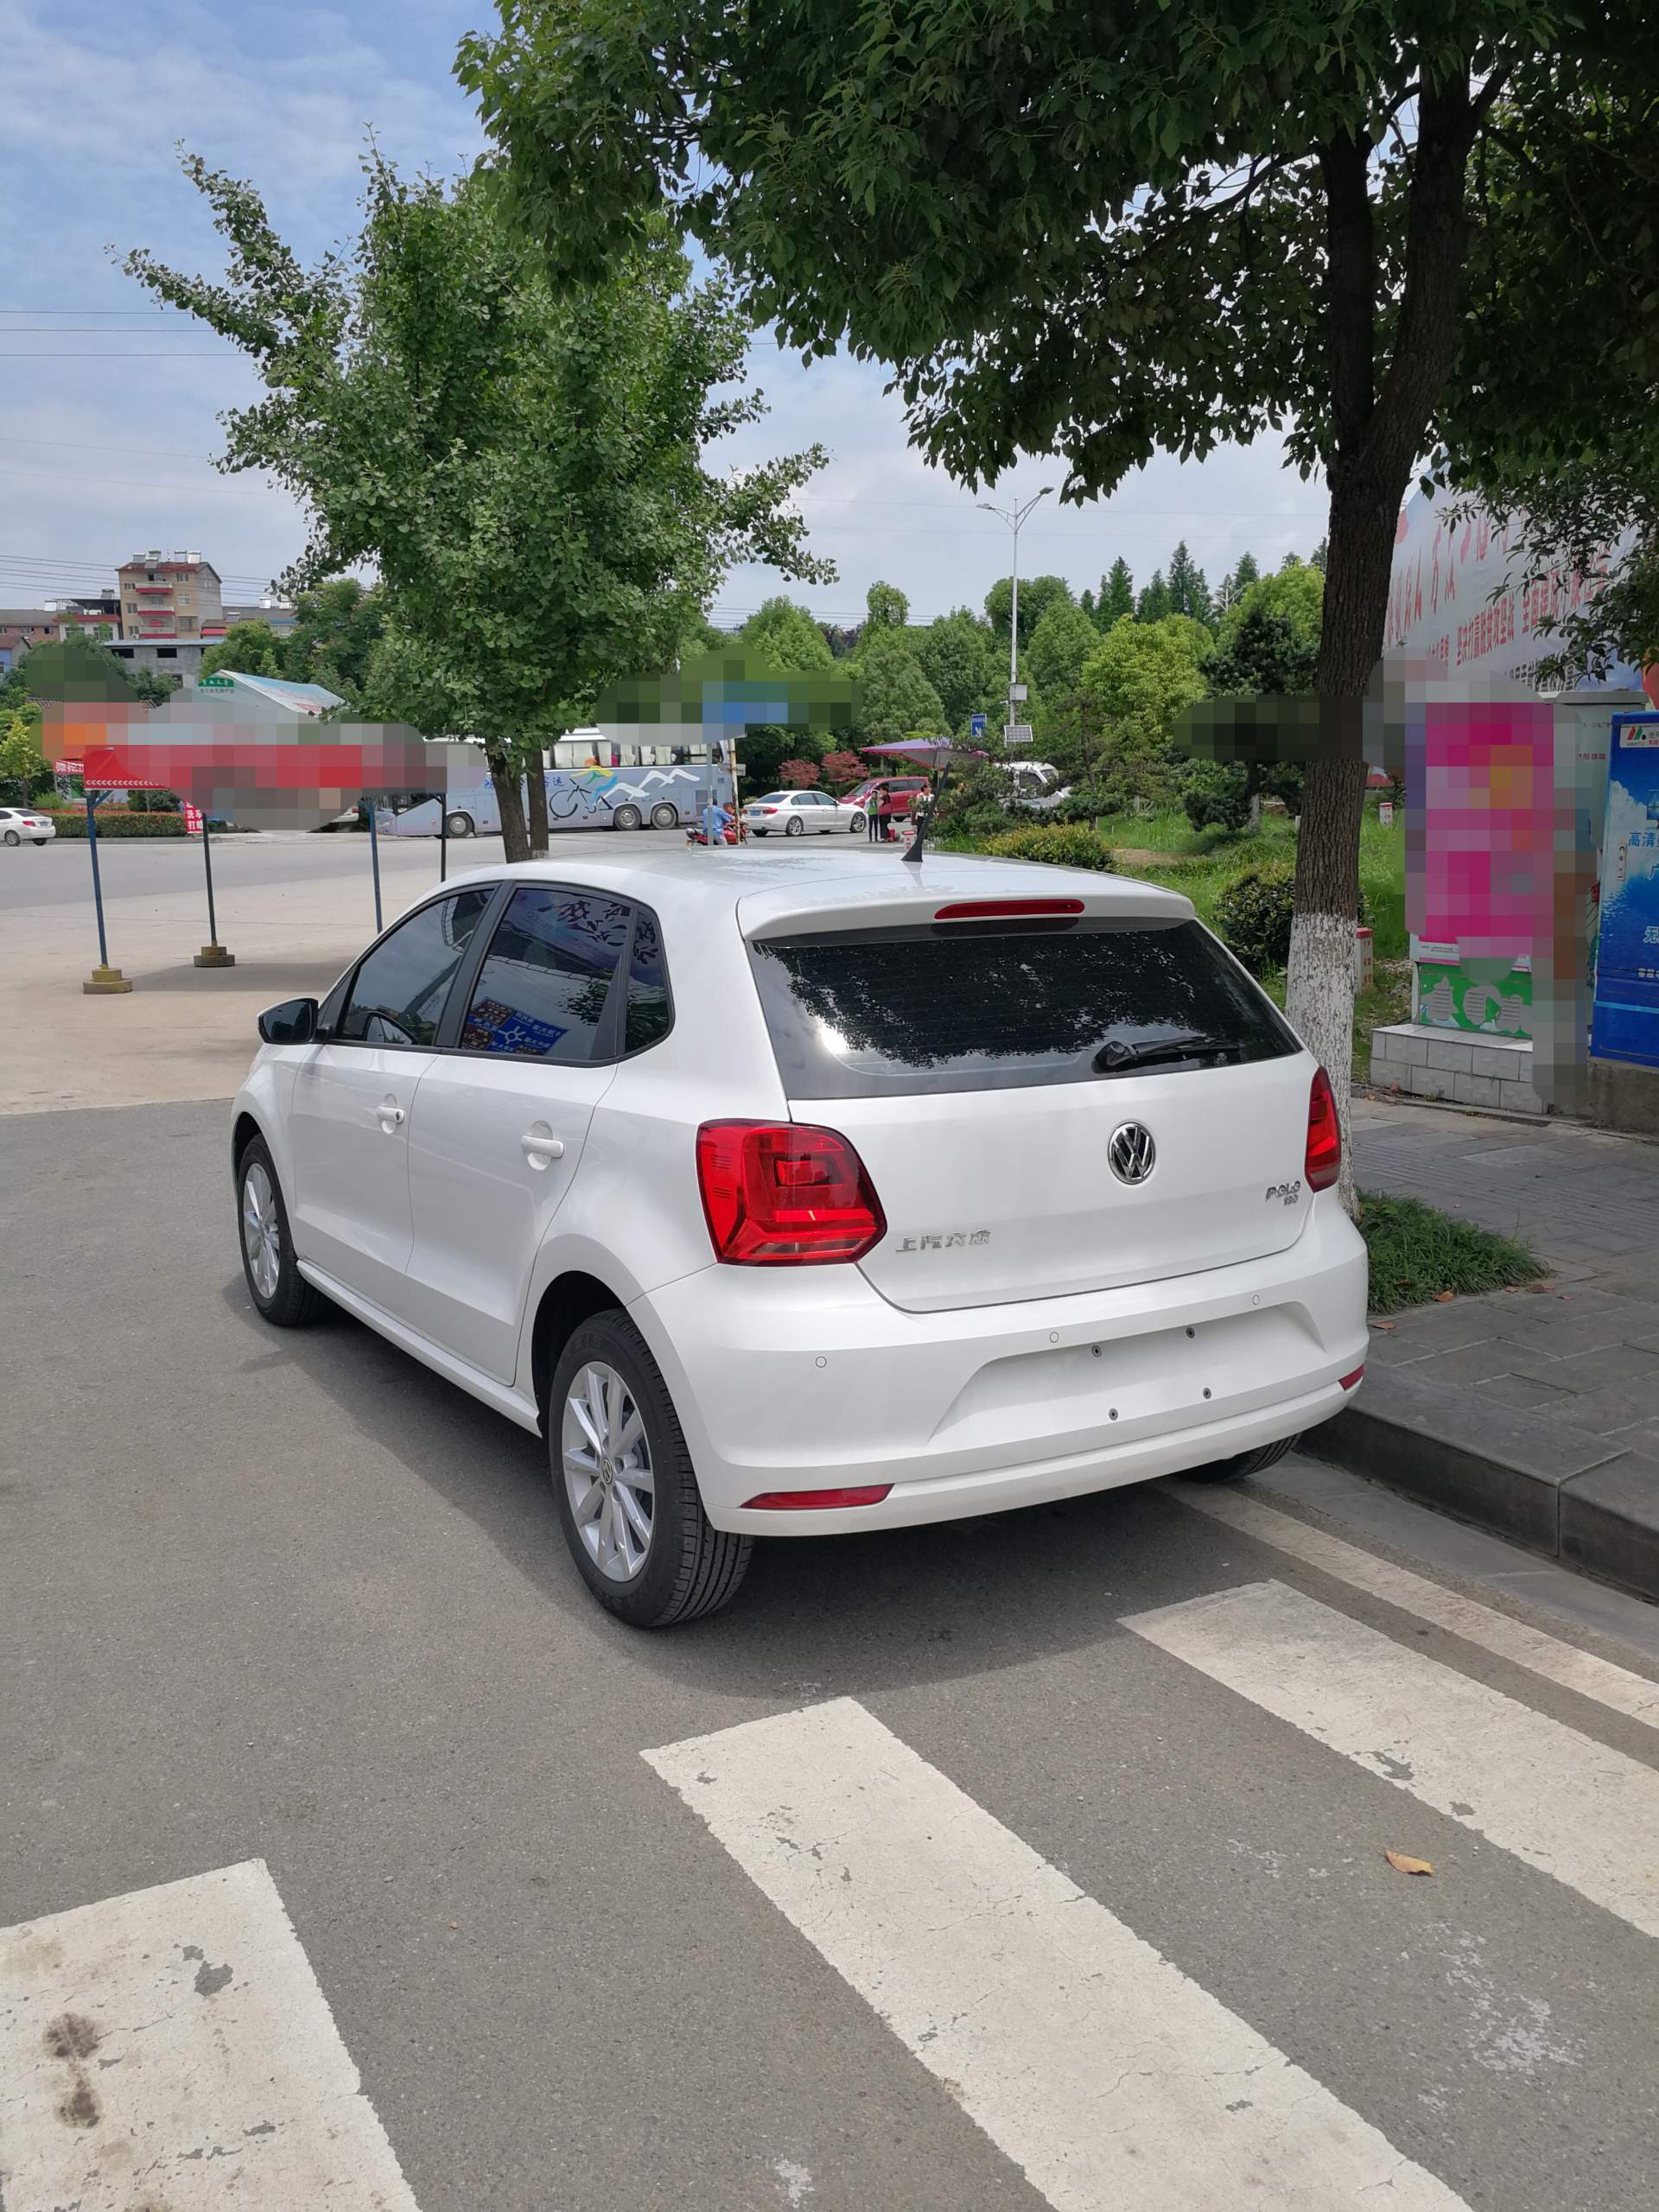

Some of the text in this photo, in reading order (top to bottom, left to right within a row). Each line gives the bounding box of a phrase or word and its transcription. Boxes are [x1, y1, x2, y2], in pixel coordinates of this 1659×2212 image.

[1265, 1180, 1301, 1202] POLO
[895, 1229, 992, 1252] 上汽大众
